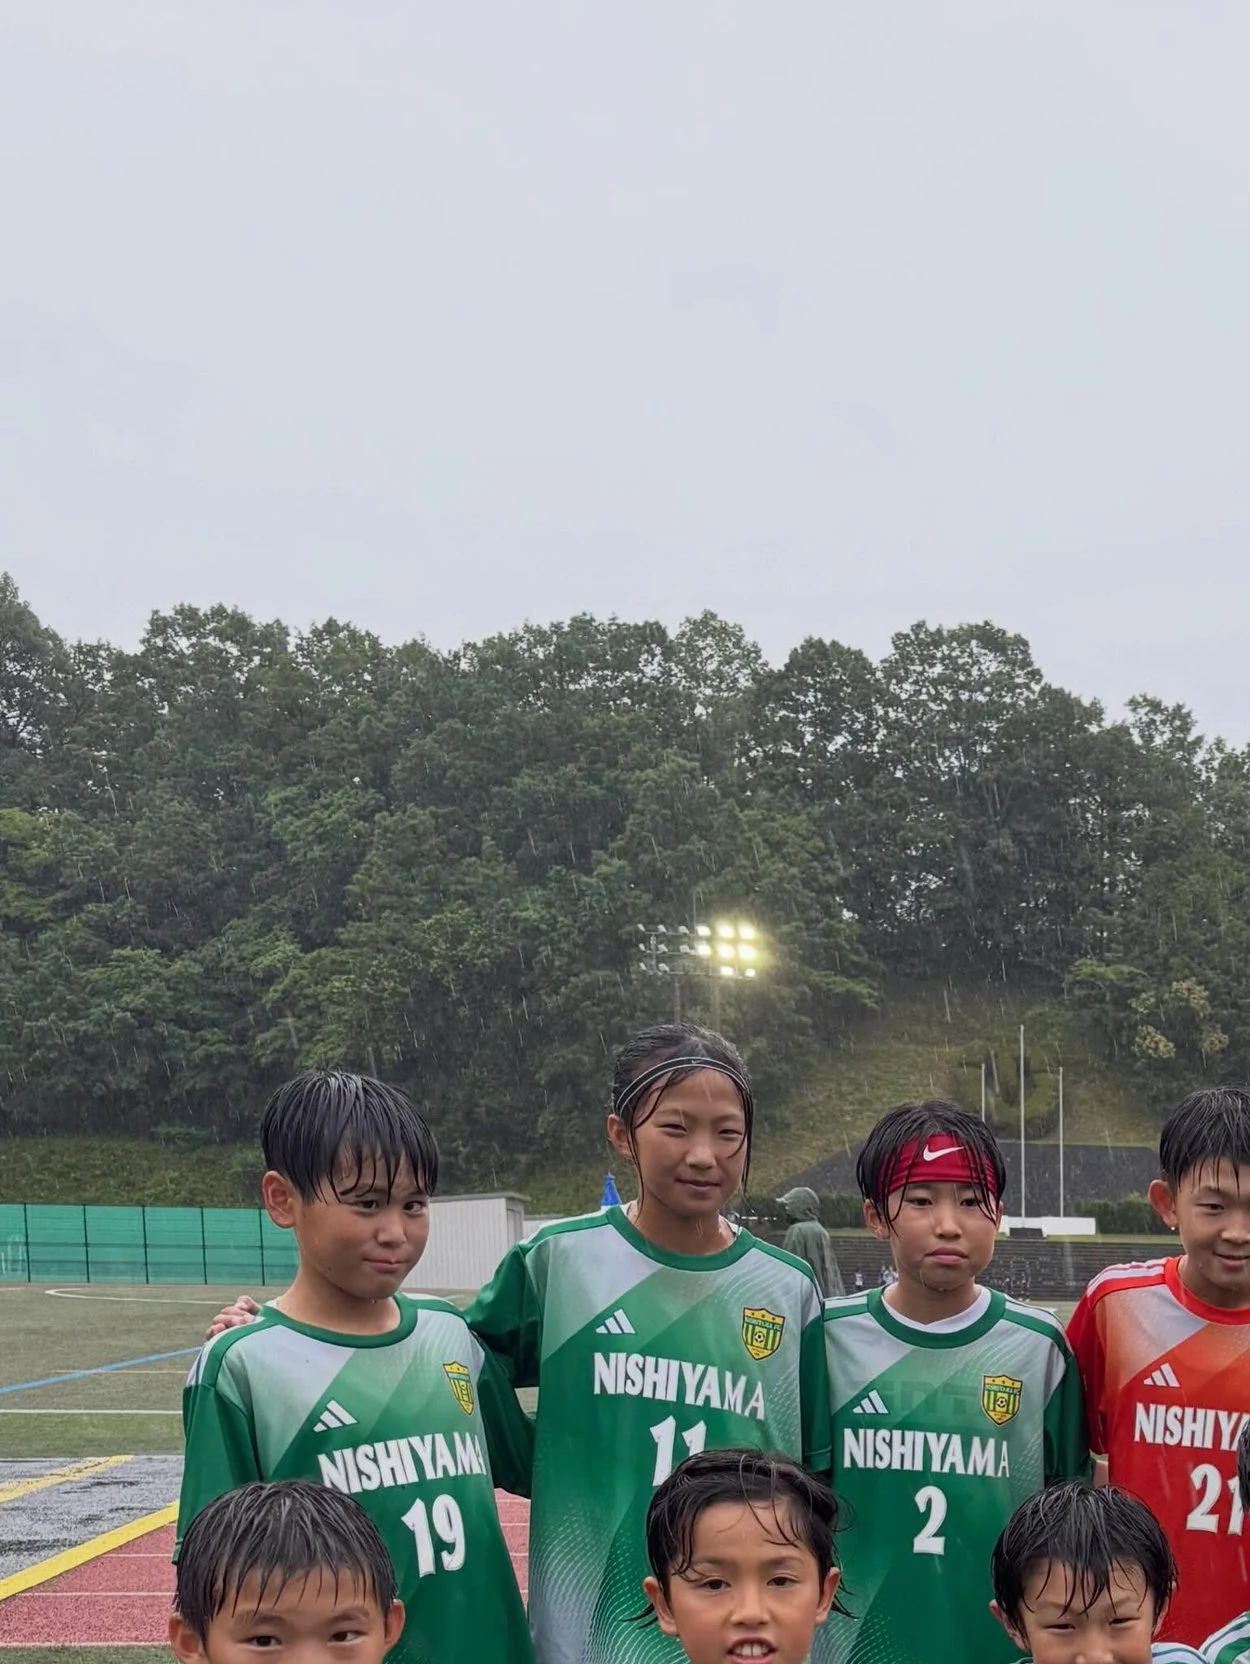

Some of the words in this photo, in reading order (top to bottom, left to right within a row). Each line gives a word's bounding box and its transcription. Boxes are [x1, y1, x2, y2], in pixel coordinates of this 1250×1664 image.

[593, 1352, 765, 1421] NISHIYAMA
[844, 1428, 1010, 1478] NISHIYAMA
[400, 1493, 466, 1578] 19
[912, 1485, 948, 1556] 2
[1186, 1463, 1244, 1537] 21
